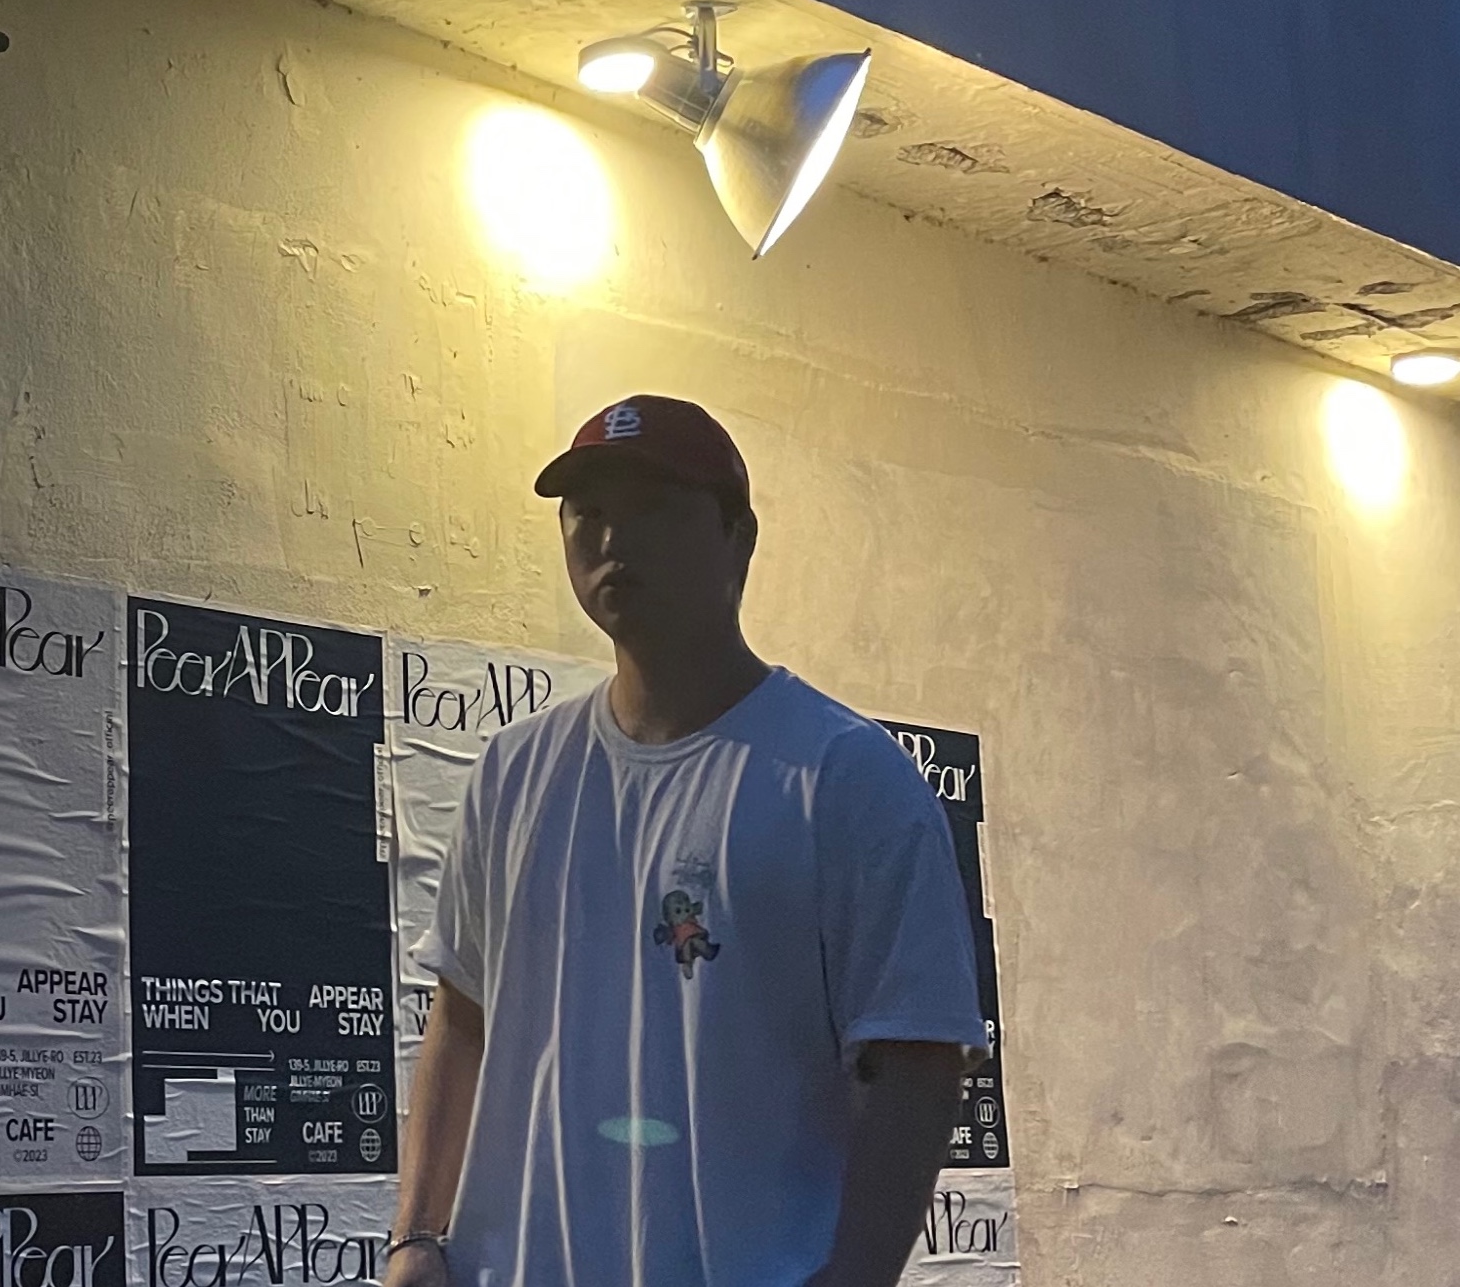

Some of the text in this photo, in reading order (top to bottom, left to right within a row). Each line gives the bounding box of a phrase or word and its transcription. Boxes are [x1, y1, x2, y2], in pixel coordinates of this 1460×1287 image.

[135, 609, 374, 718] PeerAPPear
[402, 652, 552, 732] PeerAPP
[17, 968, 108, 996] APPEAR
[141, 977, 384, 1011] THINGS THAT APPEAR
[53, 998, 108, 1024] STAY
[142, 1004, 384, 1035] WHEN YOU STAY
[244, 1085, 277, 1102] MORE
[244, 1107, 275, 1123] THAN
[6, 1118, 55, 1142] CAFE
[245, 1128, 271, 1144] STAY
[303, 1122, 343, 1144] CAFE
